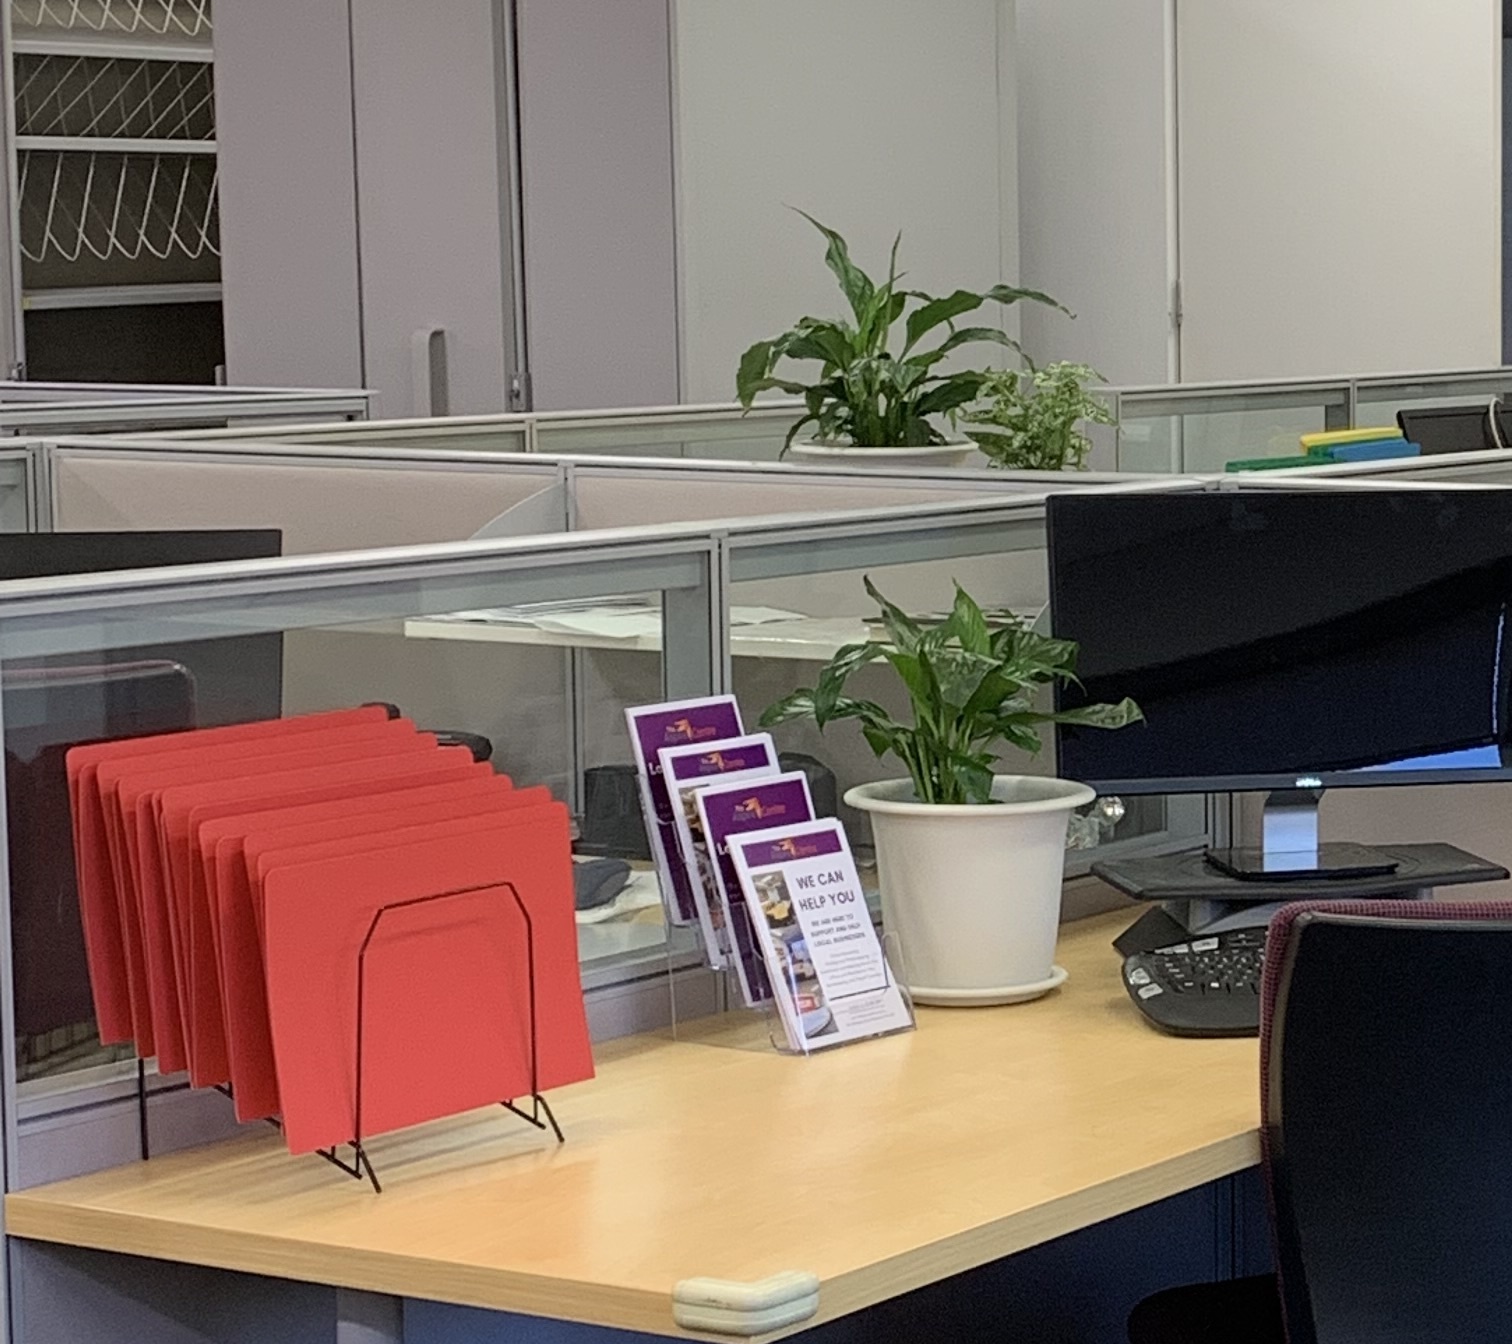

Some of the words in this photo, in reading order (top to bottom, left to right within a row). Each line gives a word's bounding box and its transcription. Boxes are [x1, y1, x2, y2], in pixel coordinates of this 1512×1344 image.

[796, 875, 816, 890] WE
[817, 870, 844, 886] CAN
[798, 897, 826, 911] HELP
[828, 890, 855, 905] YOU
